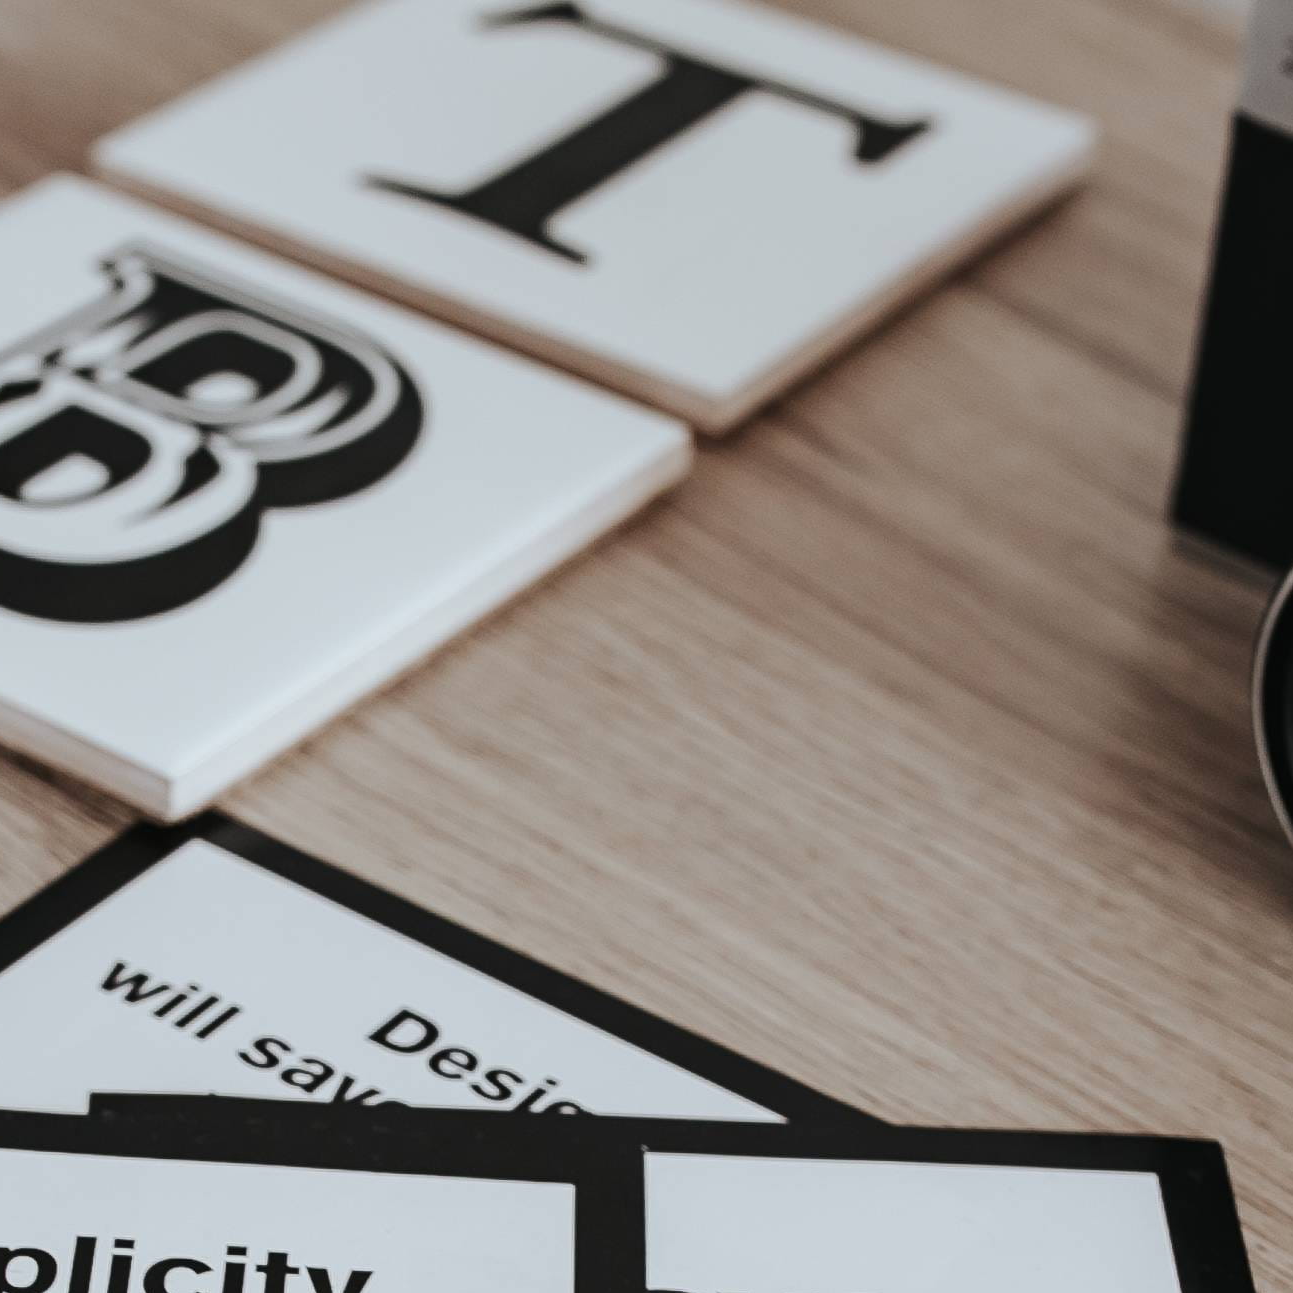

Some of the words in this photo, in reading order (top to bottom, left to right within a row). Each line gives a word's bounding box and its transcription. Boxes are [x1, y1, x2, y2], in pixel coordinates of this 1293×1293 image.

[99, 960, 241, 1040] will
[237, 1035, 407, 1106] sav
[366, 1008, 596, 1115] Desi
